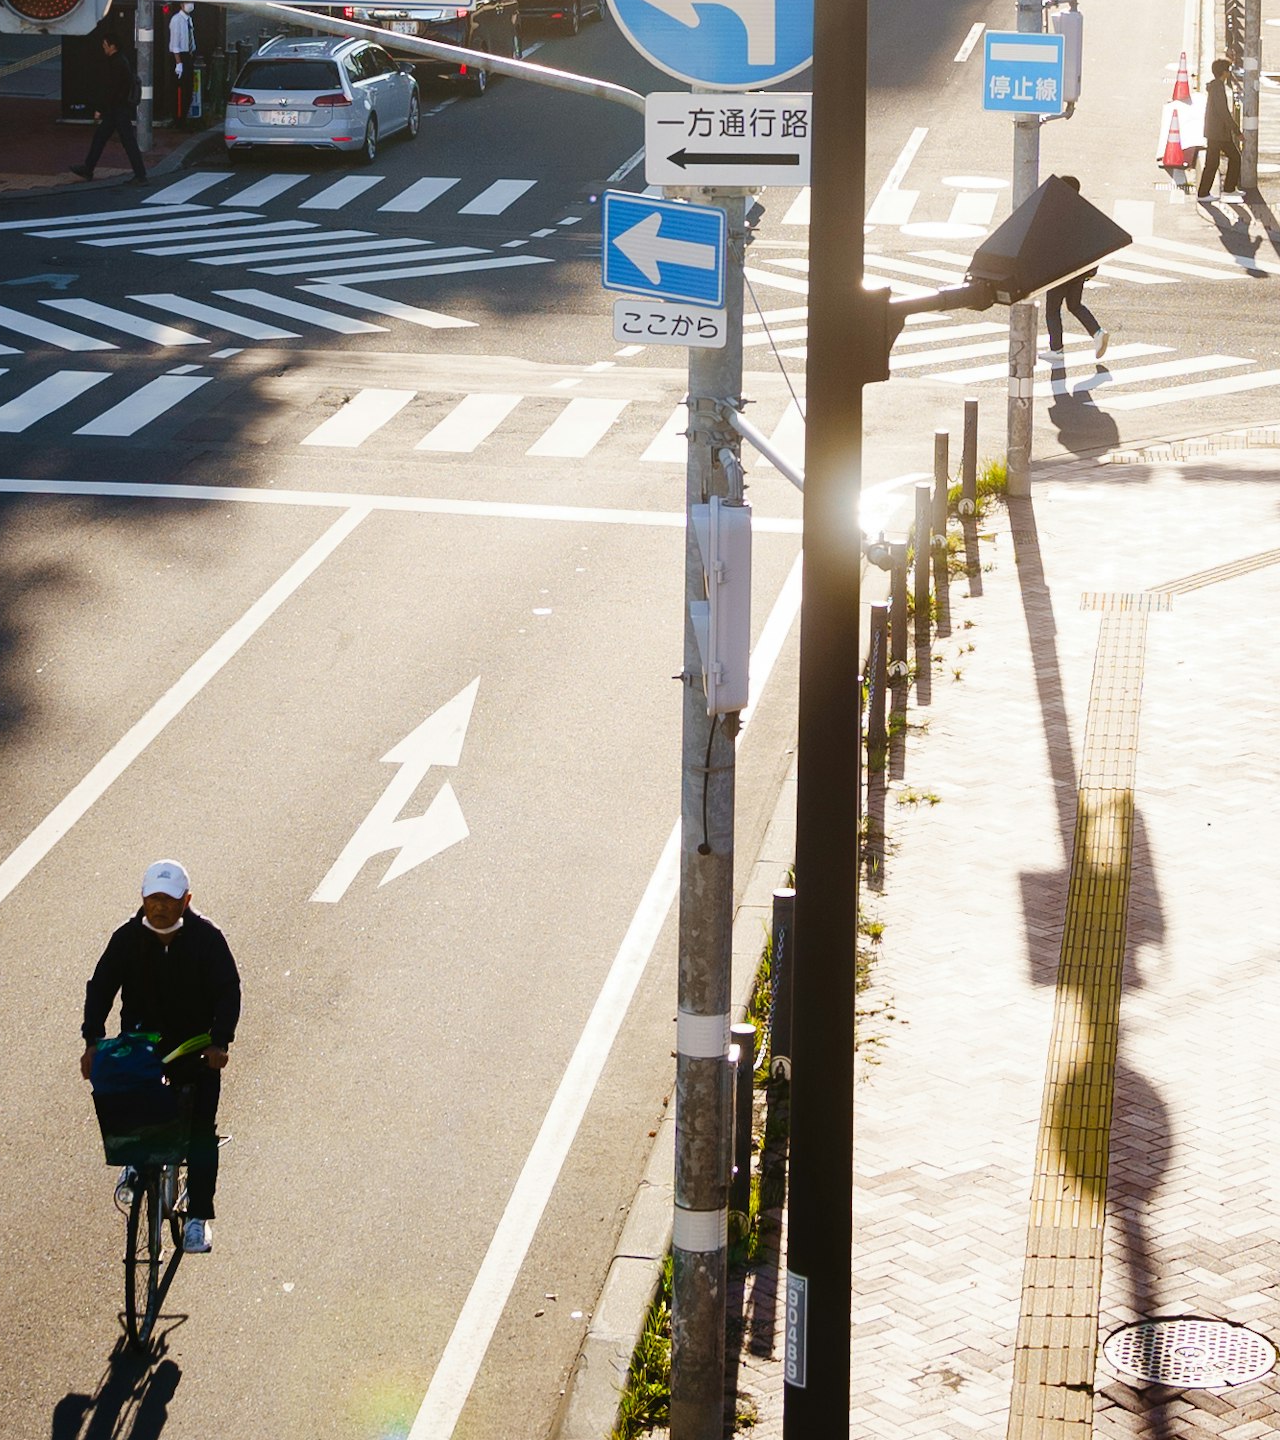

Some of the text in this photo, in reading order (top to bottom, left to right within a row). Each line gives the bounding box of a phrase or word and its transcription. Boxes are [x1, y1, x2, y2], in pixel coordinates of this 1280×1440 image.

[989, 75, 1058, 102] 停止線
[657, 107, 809, 139] 一方通行路
[622, 312, 719, 339] ここから
